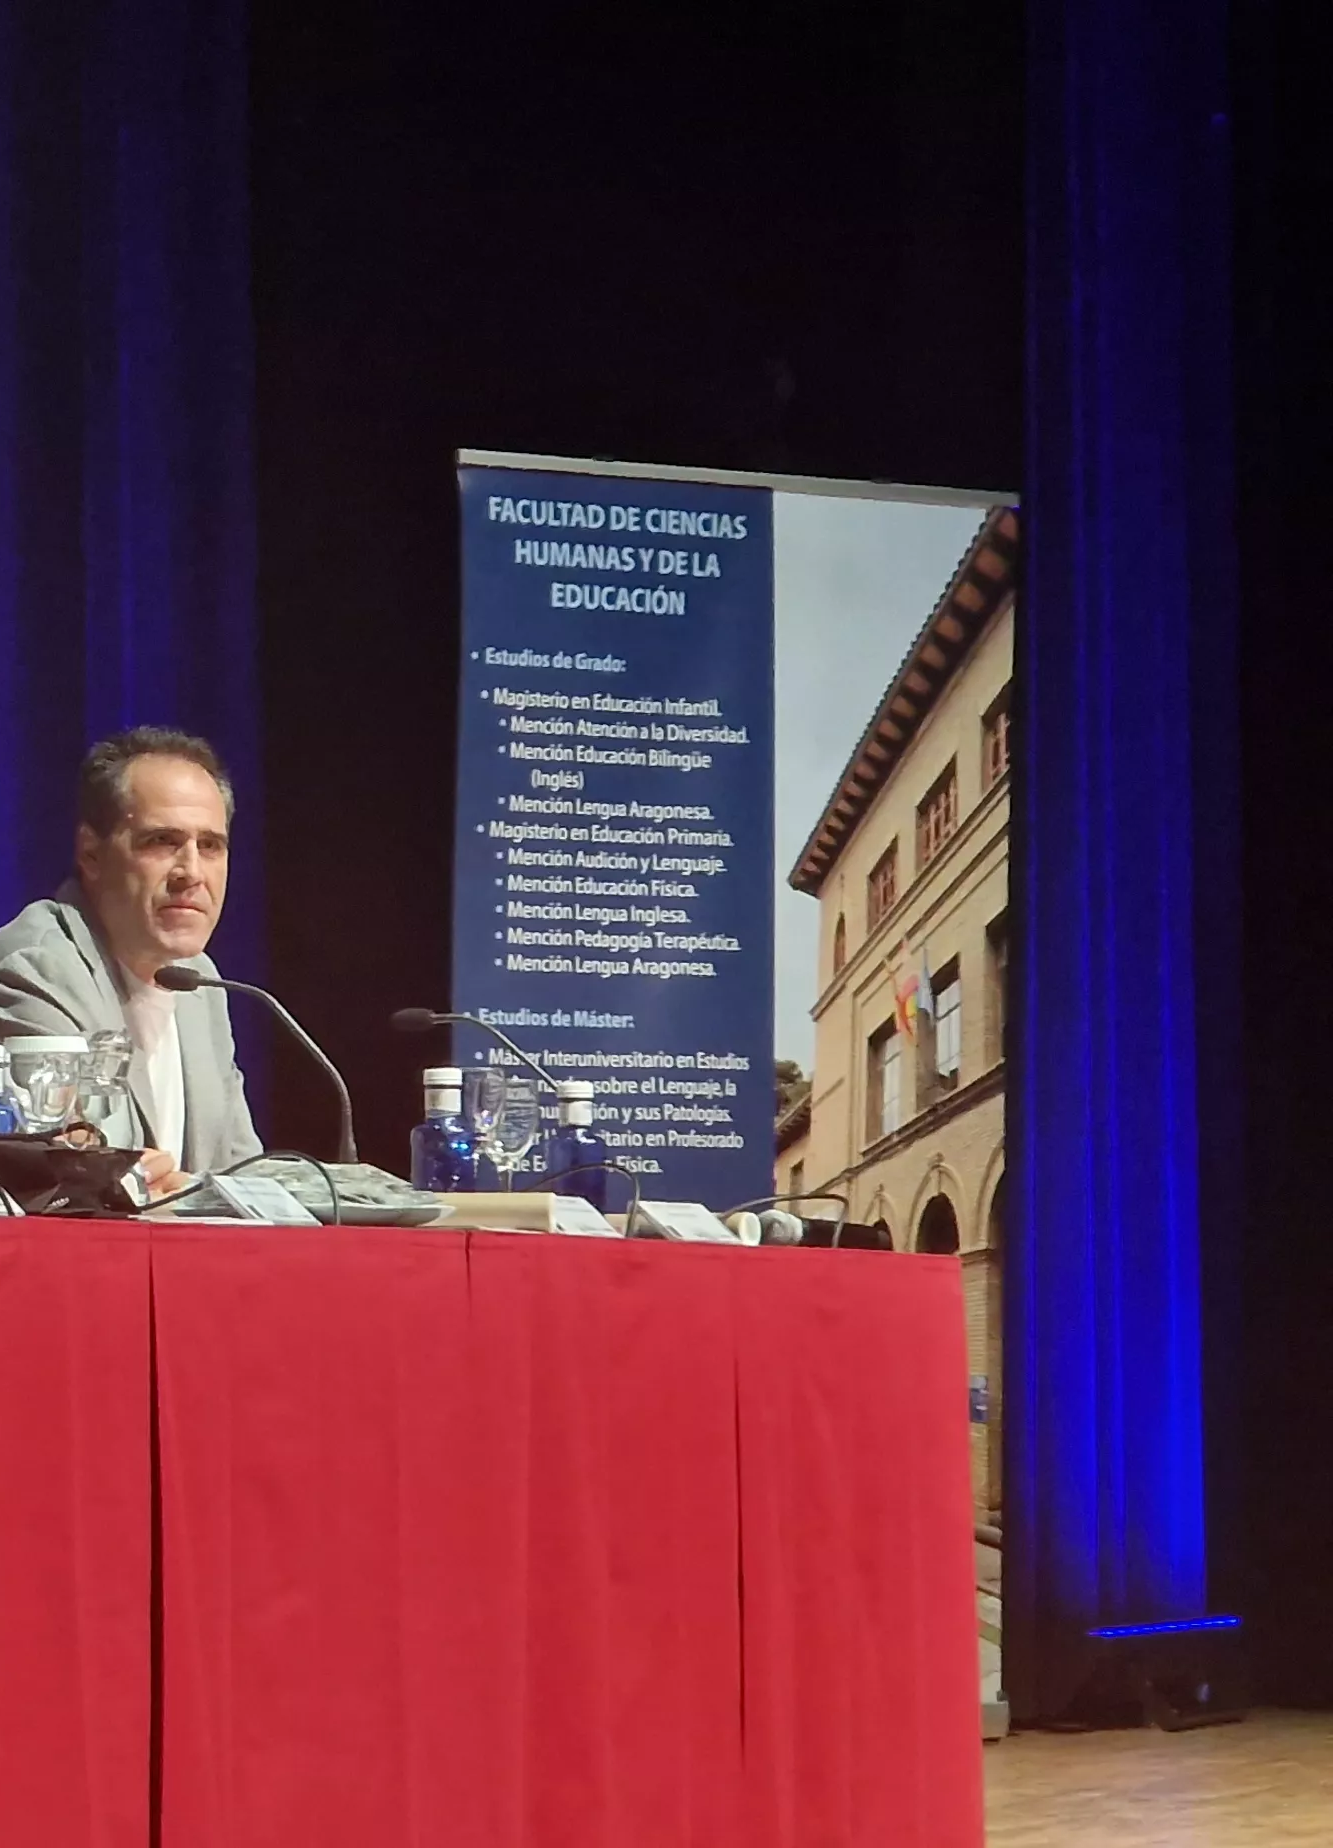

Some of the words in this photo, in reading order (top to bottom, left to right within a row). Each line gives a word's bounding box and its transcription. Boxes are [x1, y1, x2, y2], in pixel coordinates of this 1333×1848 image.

[489, 496, 605, 530] FACULTAD
[610, 506, 641, 532] DE
[645, 508, 747, 540] CIENCIAS
[515, 539, 635, 572] HUMANAS
[638, 548, 655, 572] Y
[658, 550, 689, 576] DE
[693, 552, 721, 578] LA
[551, 582, 685, 615] EDUCACIÓN
[485, 647, 550, 669] Estudios
[553, 651, 572, 670] de
[575, 653, 626, 672] Grado:
[493, 687, 569, 710] Magisterio
[571, 696, 590, 710] en
[593, 693, 661, 714] Educación
[665, 697, 723, 716] Infantil.
[511, 715, 573, 735] Mención
[577, 718, 637, 738] Atención
[641, 726, 647, 739] a
[651, 722, 663, 740] la
[667, 724, 751, 744] Diversidad.
[510, 742, 573, 762] Mención
[577, 745, 645, 766] Educación
[649, 748, 711, 772] Bilingüe
[531, 770, 584, 791] (Inglés)
[509, 794, 573, 814] Mención
[576, 798, 627, 820] Lengua
[630, 800, 715, 822] Aragonesa.
[489, 820, 567, 843] Magisterio
[571, 828, 589, 842] en
[591, 824, 664, 845] Educación
[668, 828, 735, 846] Primaria.
[507, 848, 572, 867] Mención
[575, 850, 637, 870] Audición
[640, 857, 650, 874] y
[653, 854, 727, 876] Lenguaje.
[507, 874, 573, 894] Mención
[575, 876, 649, 896] Educación
[651, 880, 699, 898] Física.
[507, 901, 572, 920] Mención
[575, 904, 627, 926] Lengua
[631, 904, 691, 927] Inglesa.
[507, 927, 572, 946] Mención
[575, 930, 652, 952] Pedagogía
[507, 954, 573, 973] Mención
[575, 956, 629, 978] Lengua
[633, 958, 717, 978] Aragonesa.
[479, 1008, 548, 1027] Estudios
[551, 1010, 570, 1026] de
[574, 1010, 635, 1029] Máster:
[543, 1049, 673, 1070] Interuniversitario
[676, 1056, 695, 1068] en
[697, 1052, 749, 1070] Estudios
[594, 1078, 637, 1095] sobre
[641, 1078, 656, 1094] el
[659, 1078, 723, 1100] Lenguaje,
[725, 1078, 737, 1096] la
[622, 1110, 633, 1124] y
[635, 1109, 661, 1120] sus
[664, 1104, 733, 1126] Patologías.
[647, 1134, 665, 1147] en
[668, 1130, 744, 1148] Profesorado
